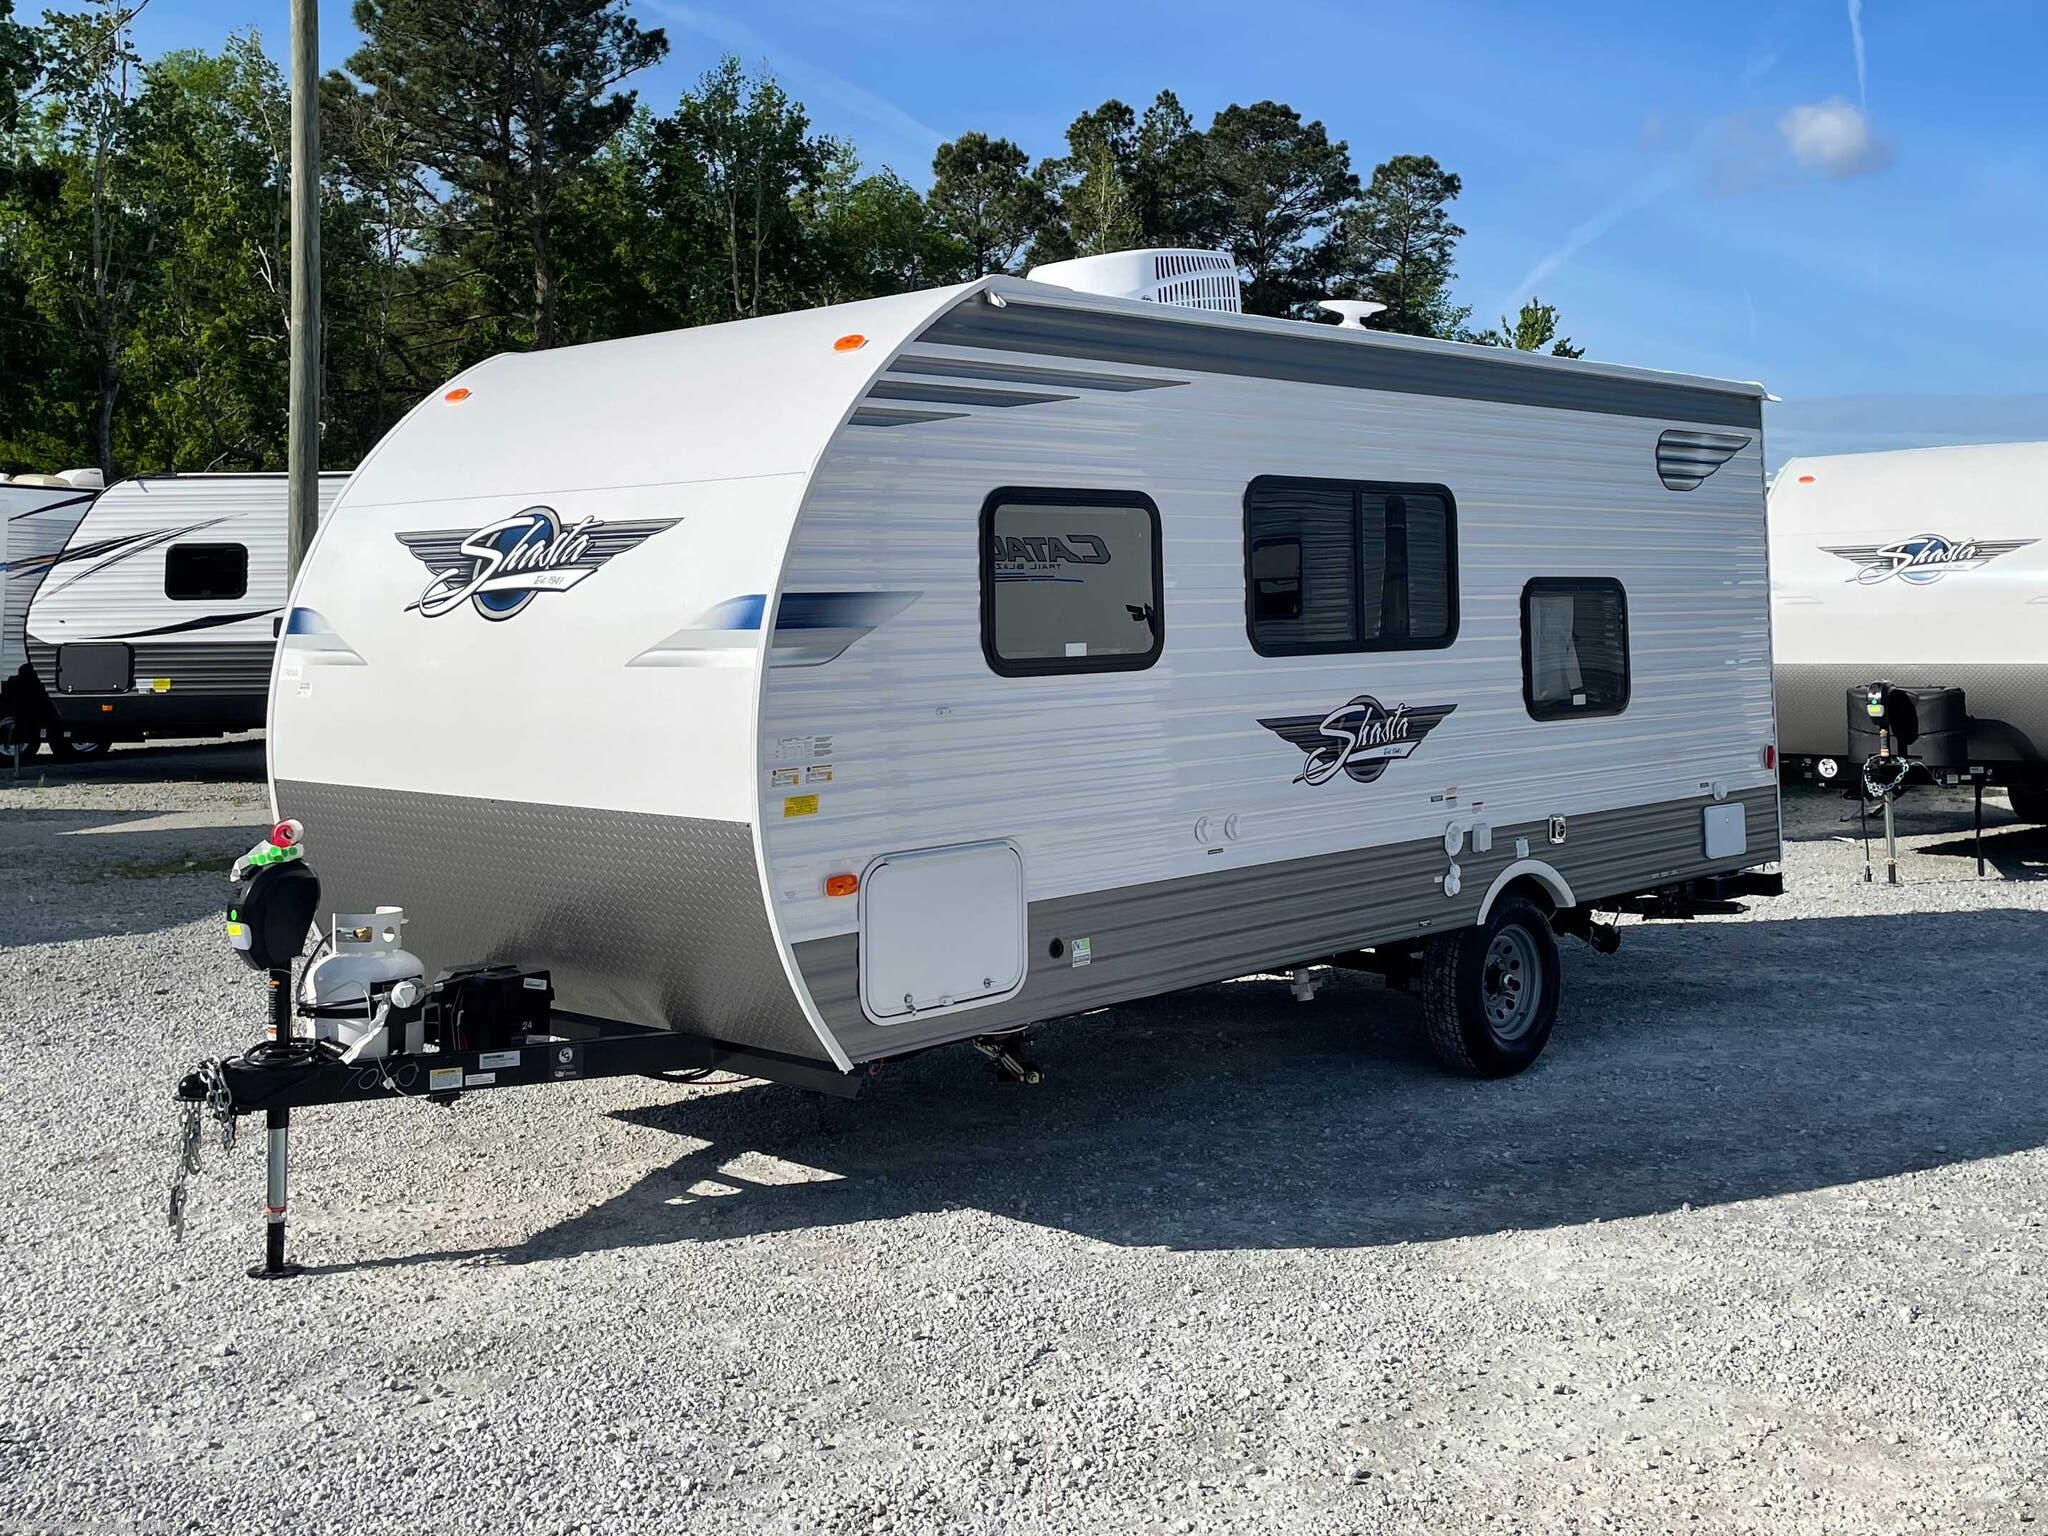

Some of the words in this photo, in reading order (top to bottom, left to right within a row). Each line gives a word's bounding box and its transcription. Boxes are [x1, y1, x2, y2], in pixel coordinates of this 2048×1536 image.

[414, 514, 604, 619] Shasta
[1850, 537, 1983, 586] Shasta
[1298, 702, 1412, 786] Shasta
[521, 1020, 533, 1030] 24
